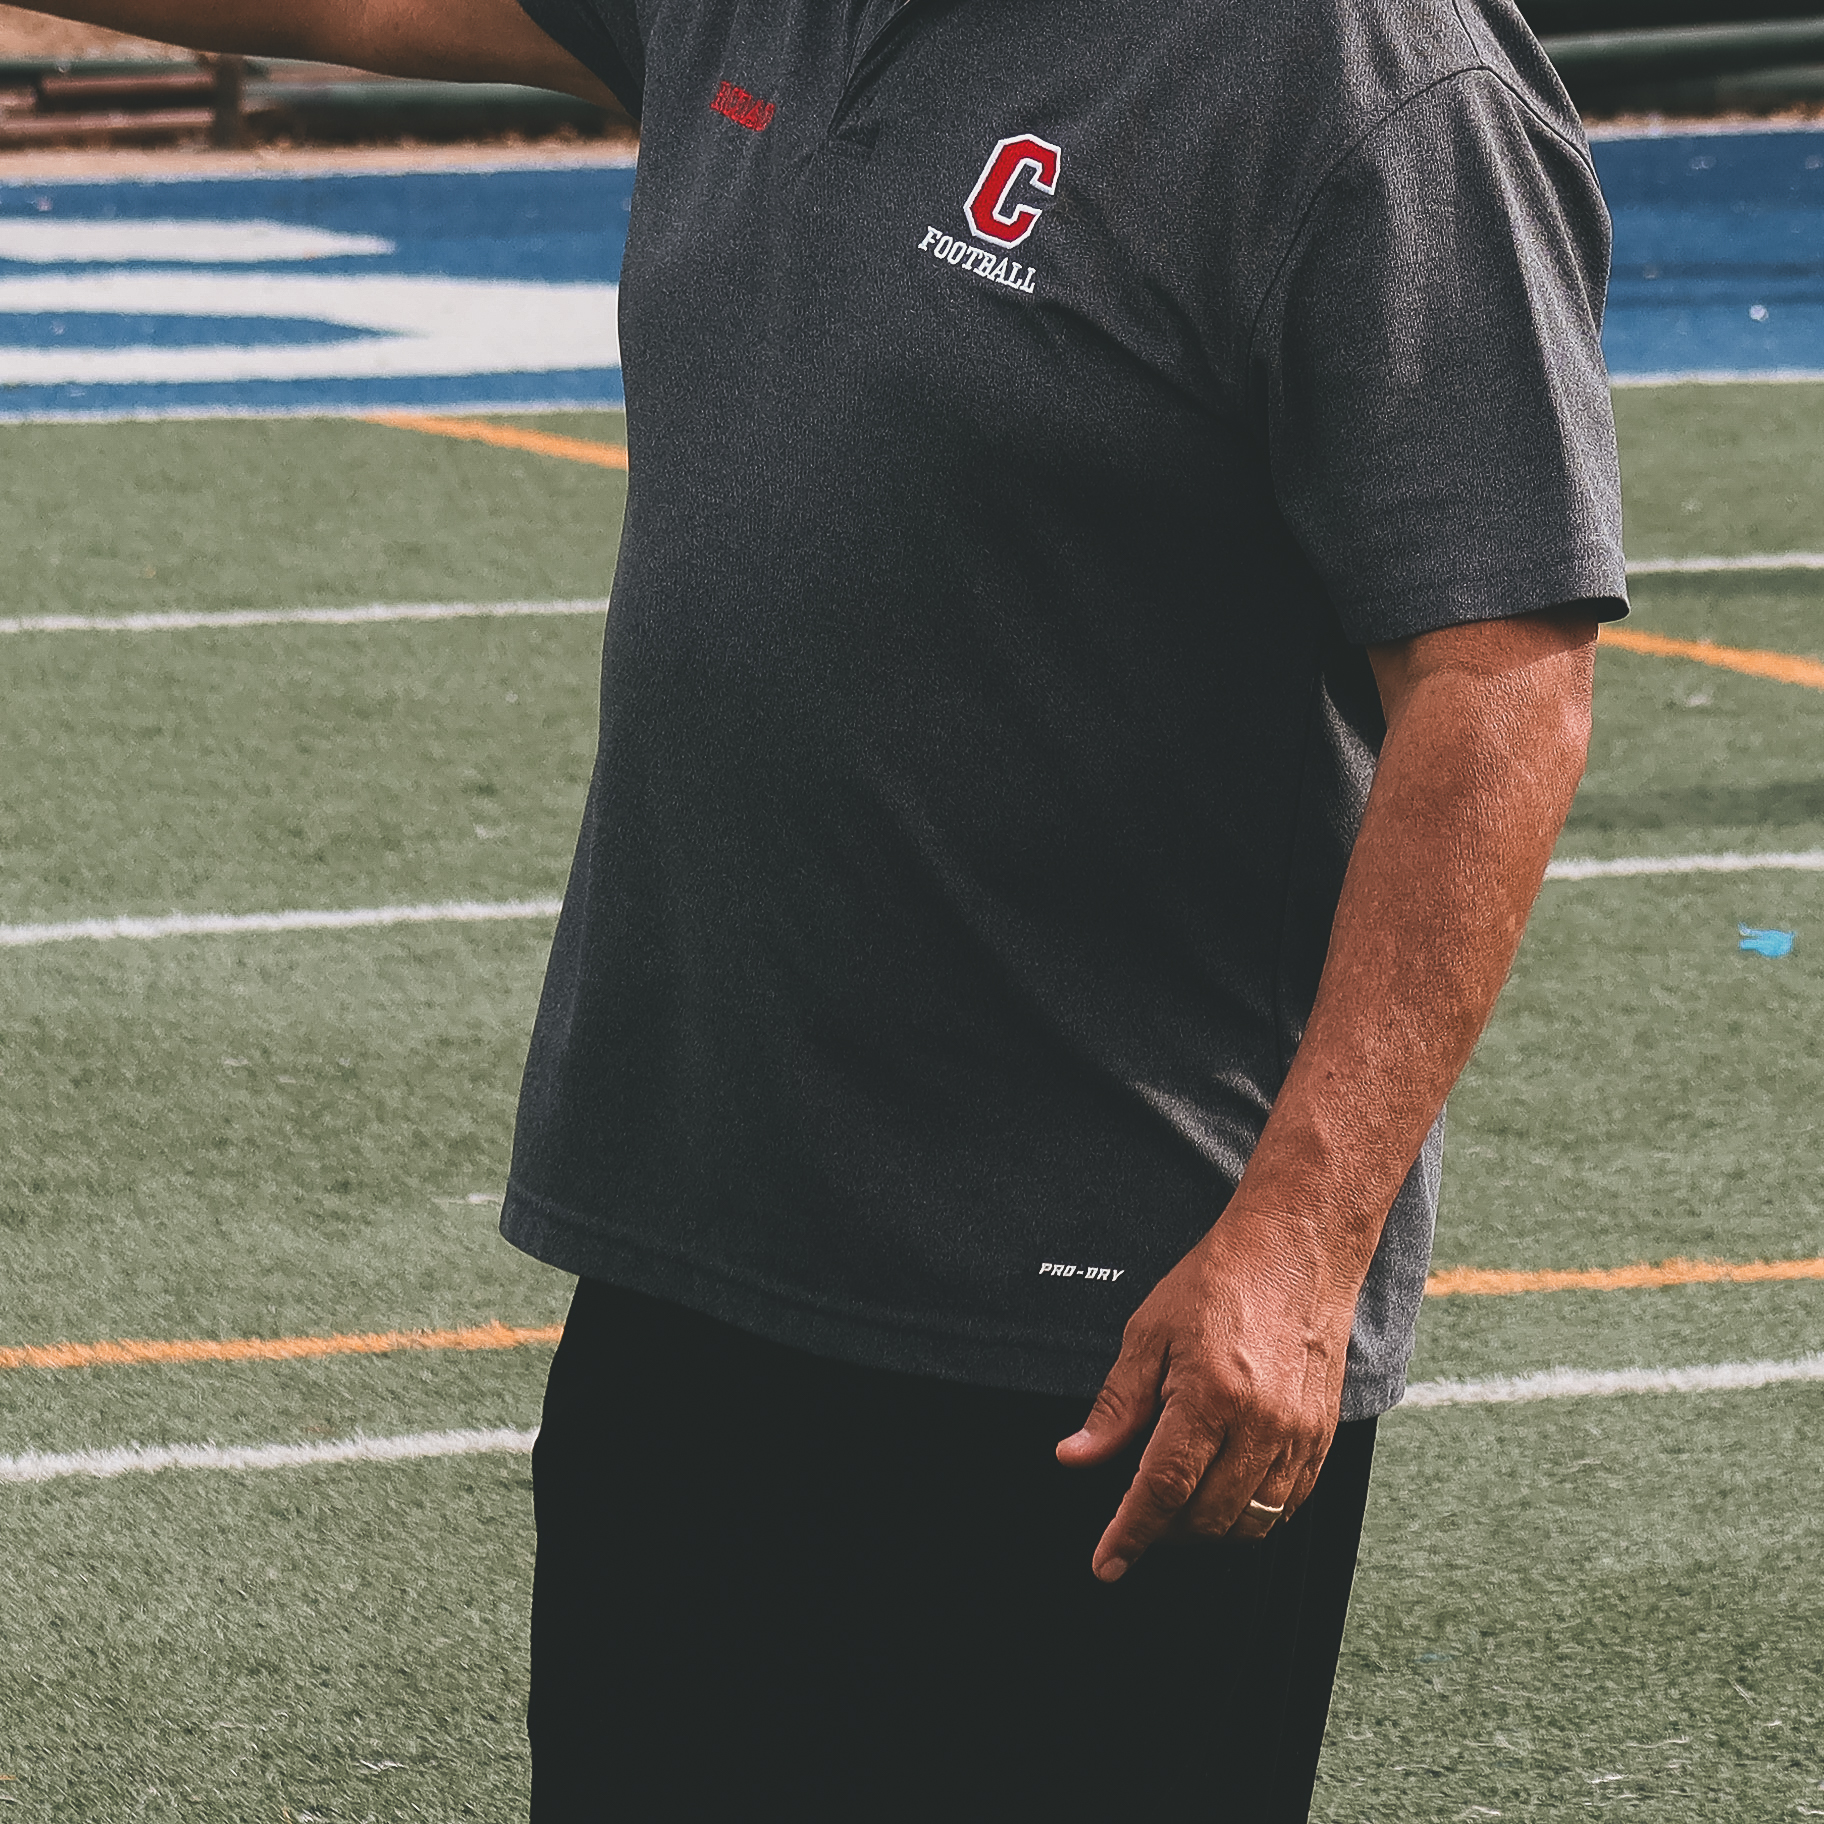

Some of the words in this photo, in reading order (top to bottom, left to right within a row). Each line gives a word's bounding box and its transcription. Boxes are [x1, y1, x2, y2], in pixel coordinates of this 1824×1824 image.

[963, 133, 1062, 250] C
[918, 225, 1037, 295] FOOTBALL
[1038, 1262, 1125, 1282] PRO-DRY
